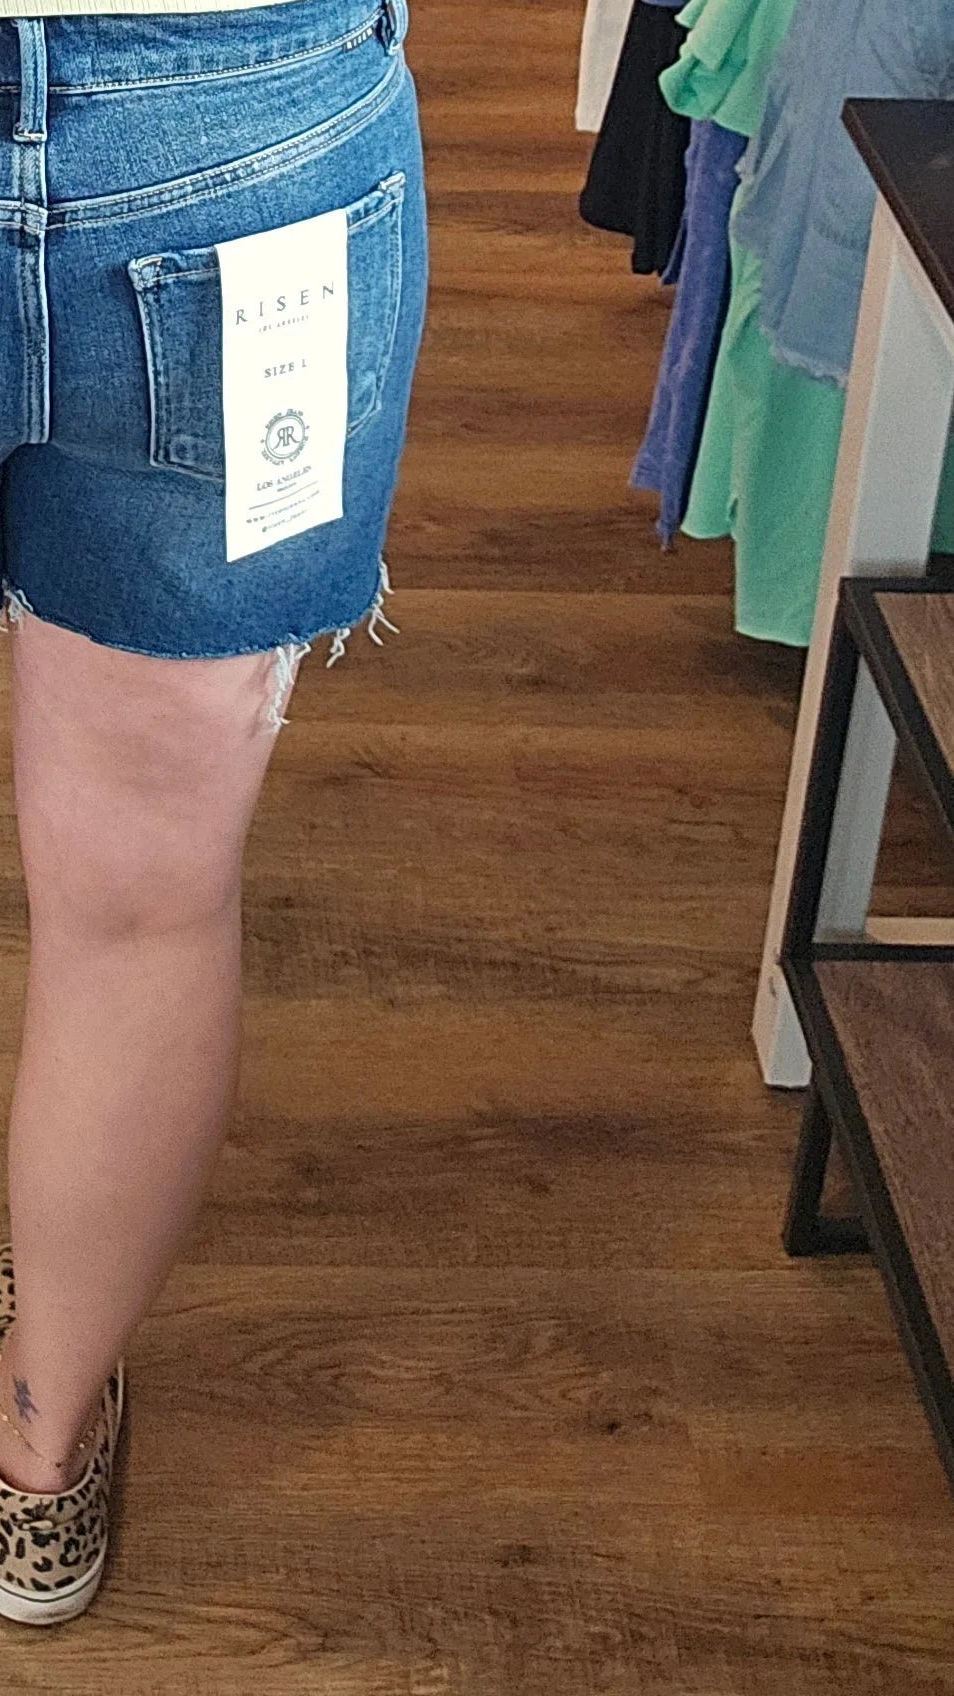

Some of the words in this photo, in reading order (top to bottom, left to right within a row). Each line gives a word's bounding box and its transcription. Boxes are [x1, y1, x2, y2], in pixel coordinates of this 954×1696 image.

[236, 280, 334, 325] RISEN
[264, 361, 295, 379] SIZE
[301, 358, 308, 368] L
[257, 479, 273, 491] LOS
